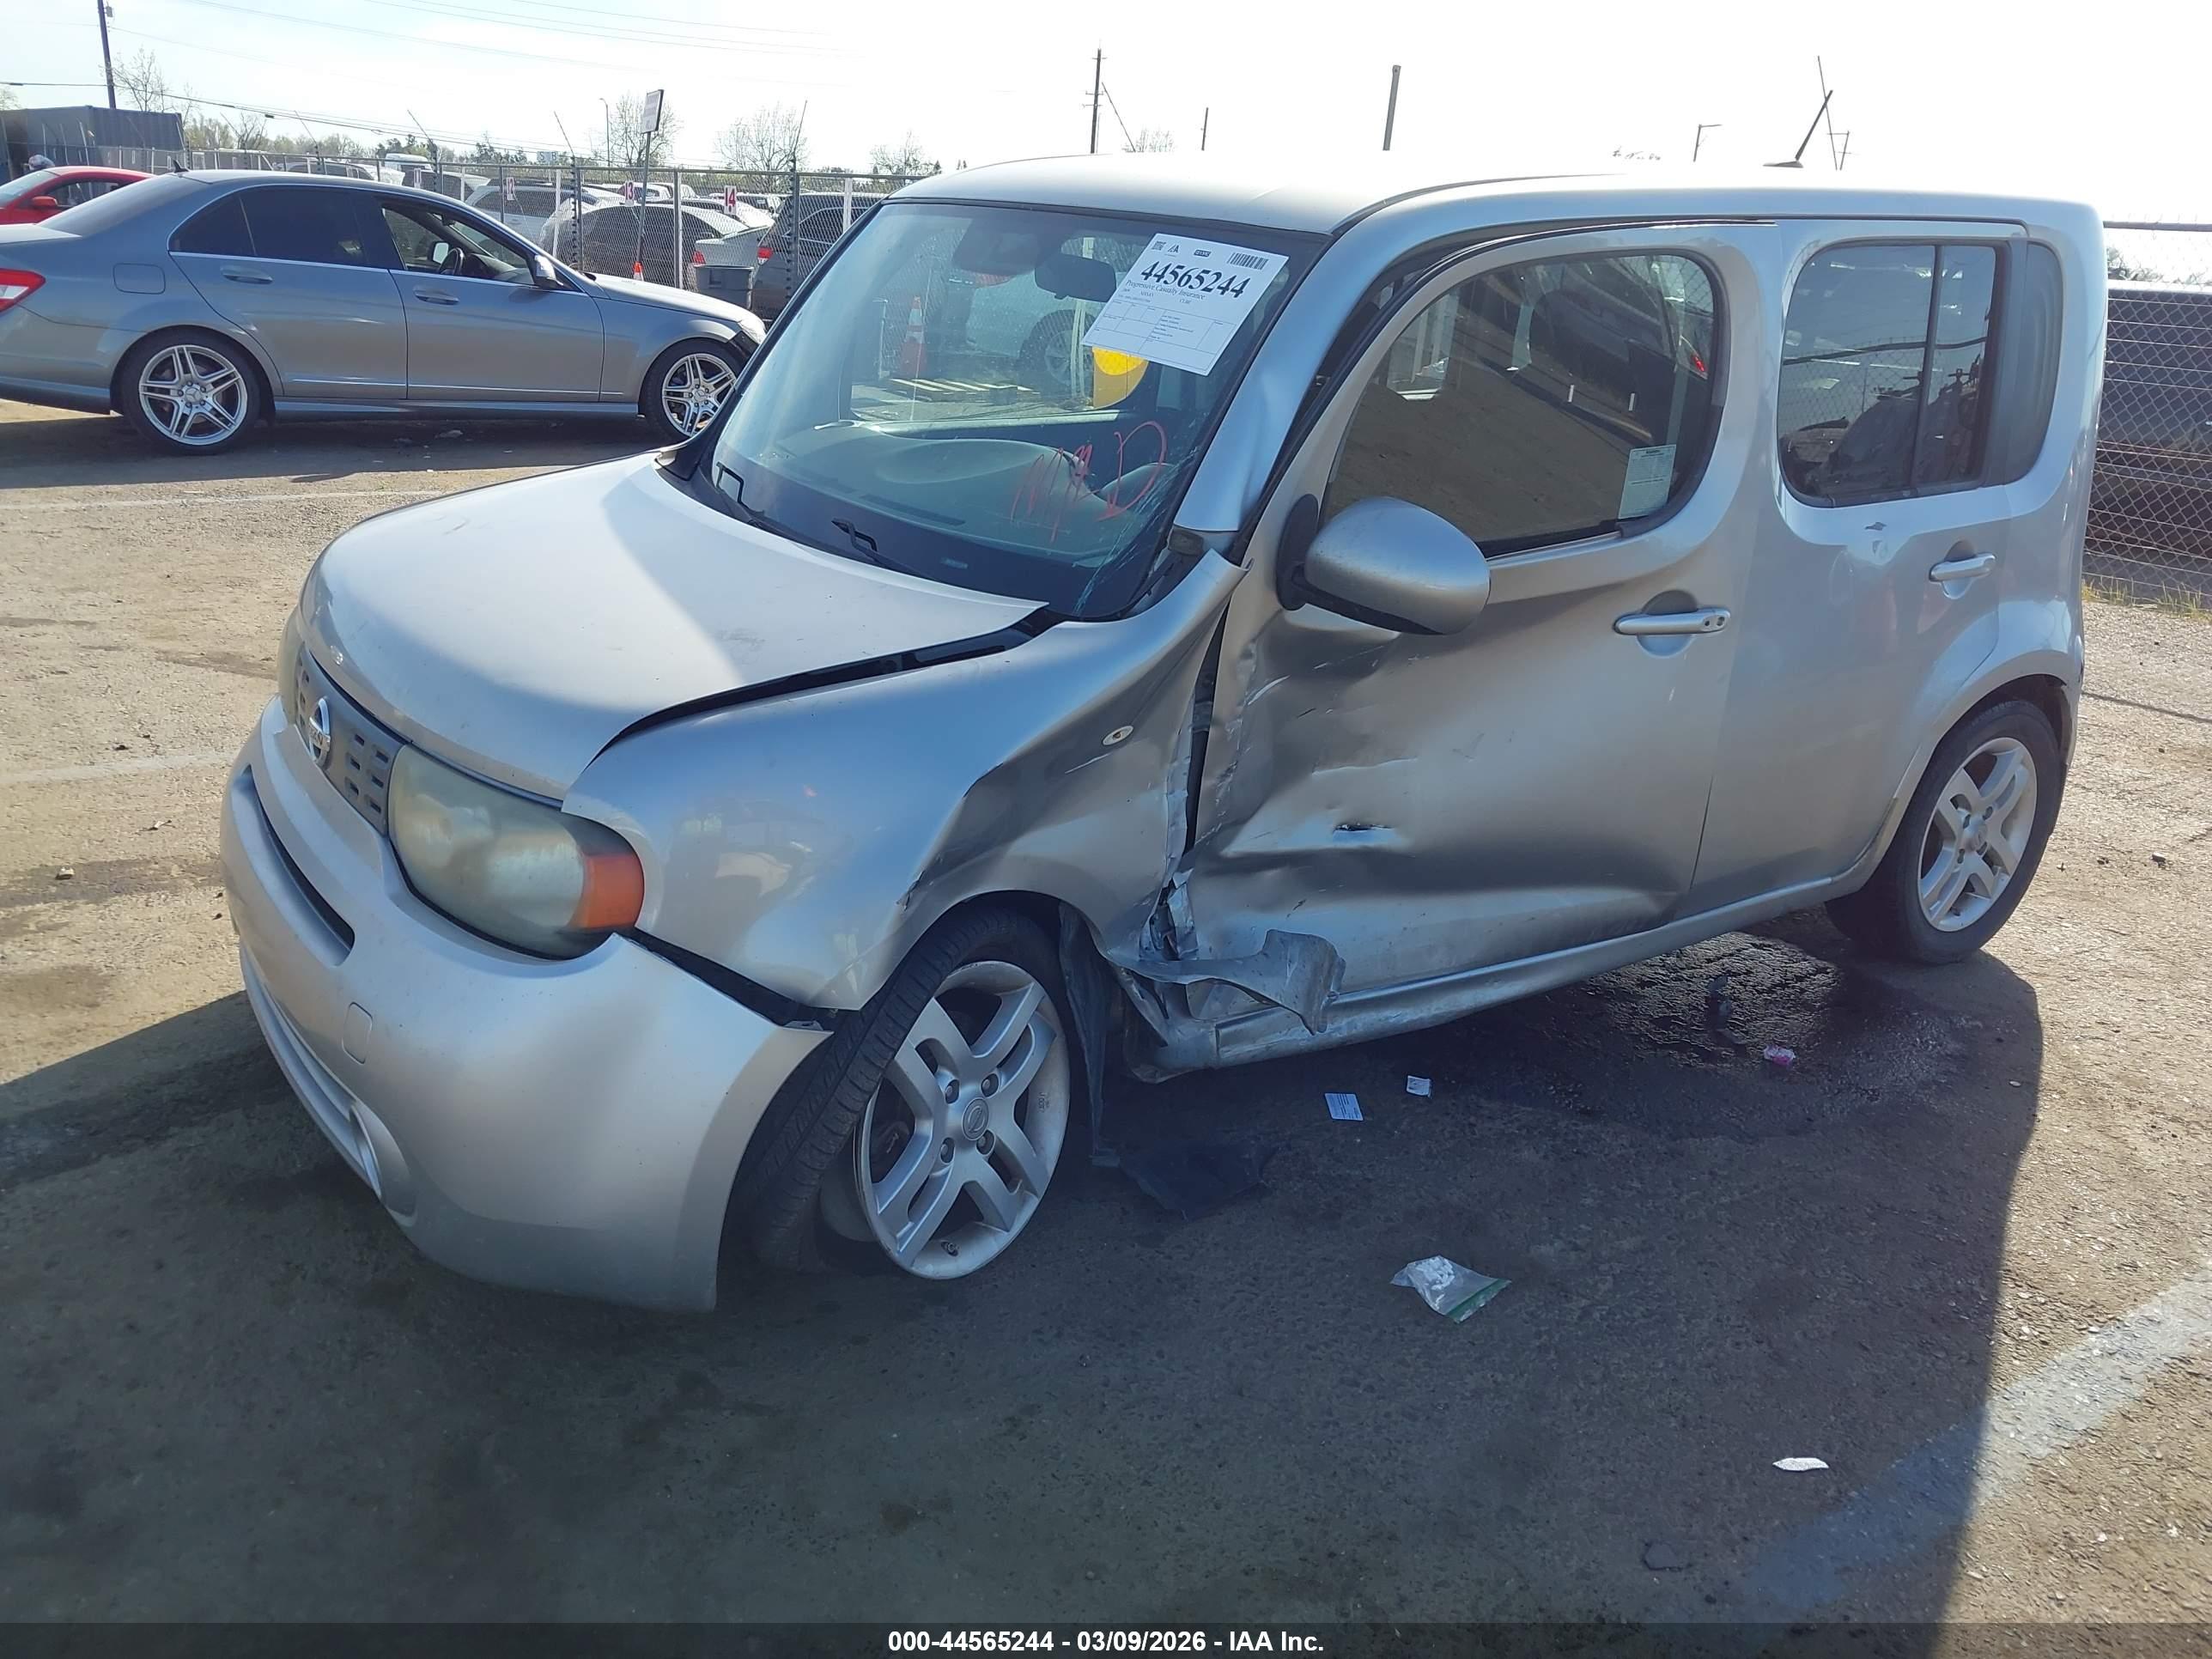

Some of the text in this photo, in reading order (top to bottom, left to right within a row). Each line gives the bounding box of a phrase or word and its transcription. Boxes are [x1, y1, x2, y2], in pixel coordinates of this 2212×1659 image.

[625, 182, 634, 200] 13
[725, 187, 736, 207] 14
[1140, 260, 1251, 298] 44565244
